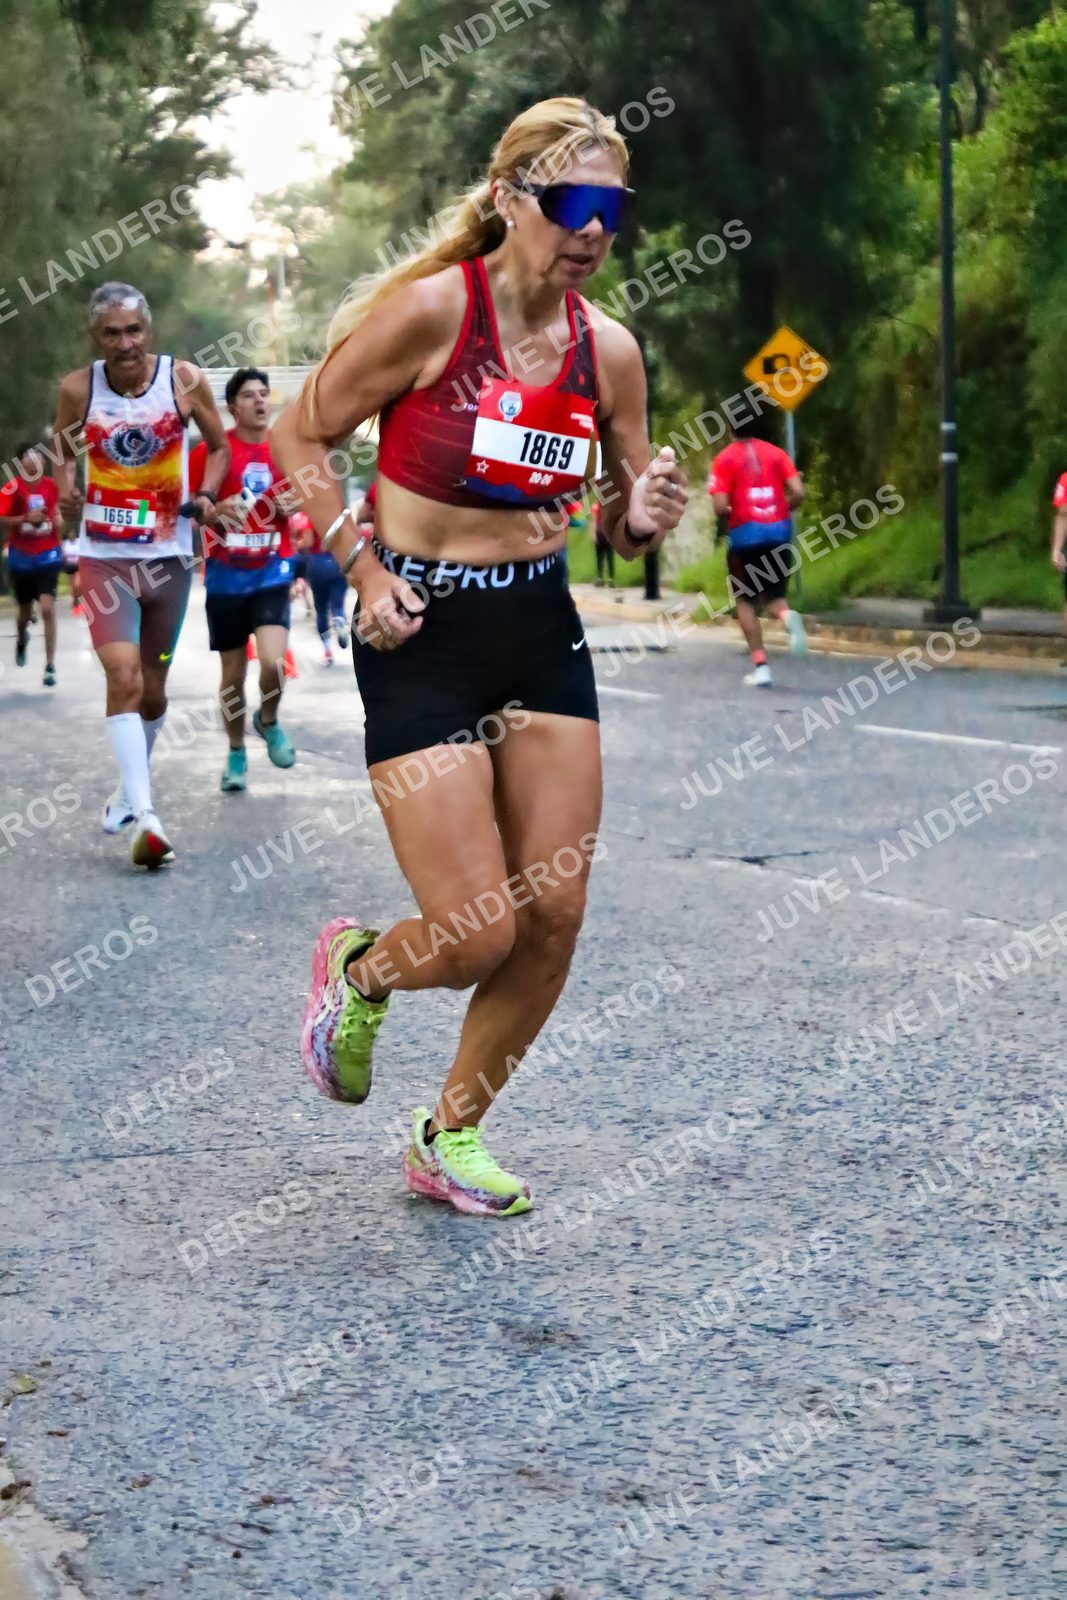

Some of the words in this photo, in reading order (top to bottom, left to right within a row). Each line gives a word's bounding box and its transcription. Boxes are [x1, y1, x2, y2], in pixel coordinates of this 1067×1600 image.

[519, 431, 576, 471] 1869
[103, 507, 133, 525] 1655
[433, 560, 515, 589] PRO
